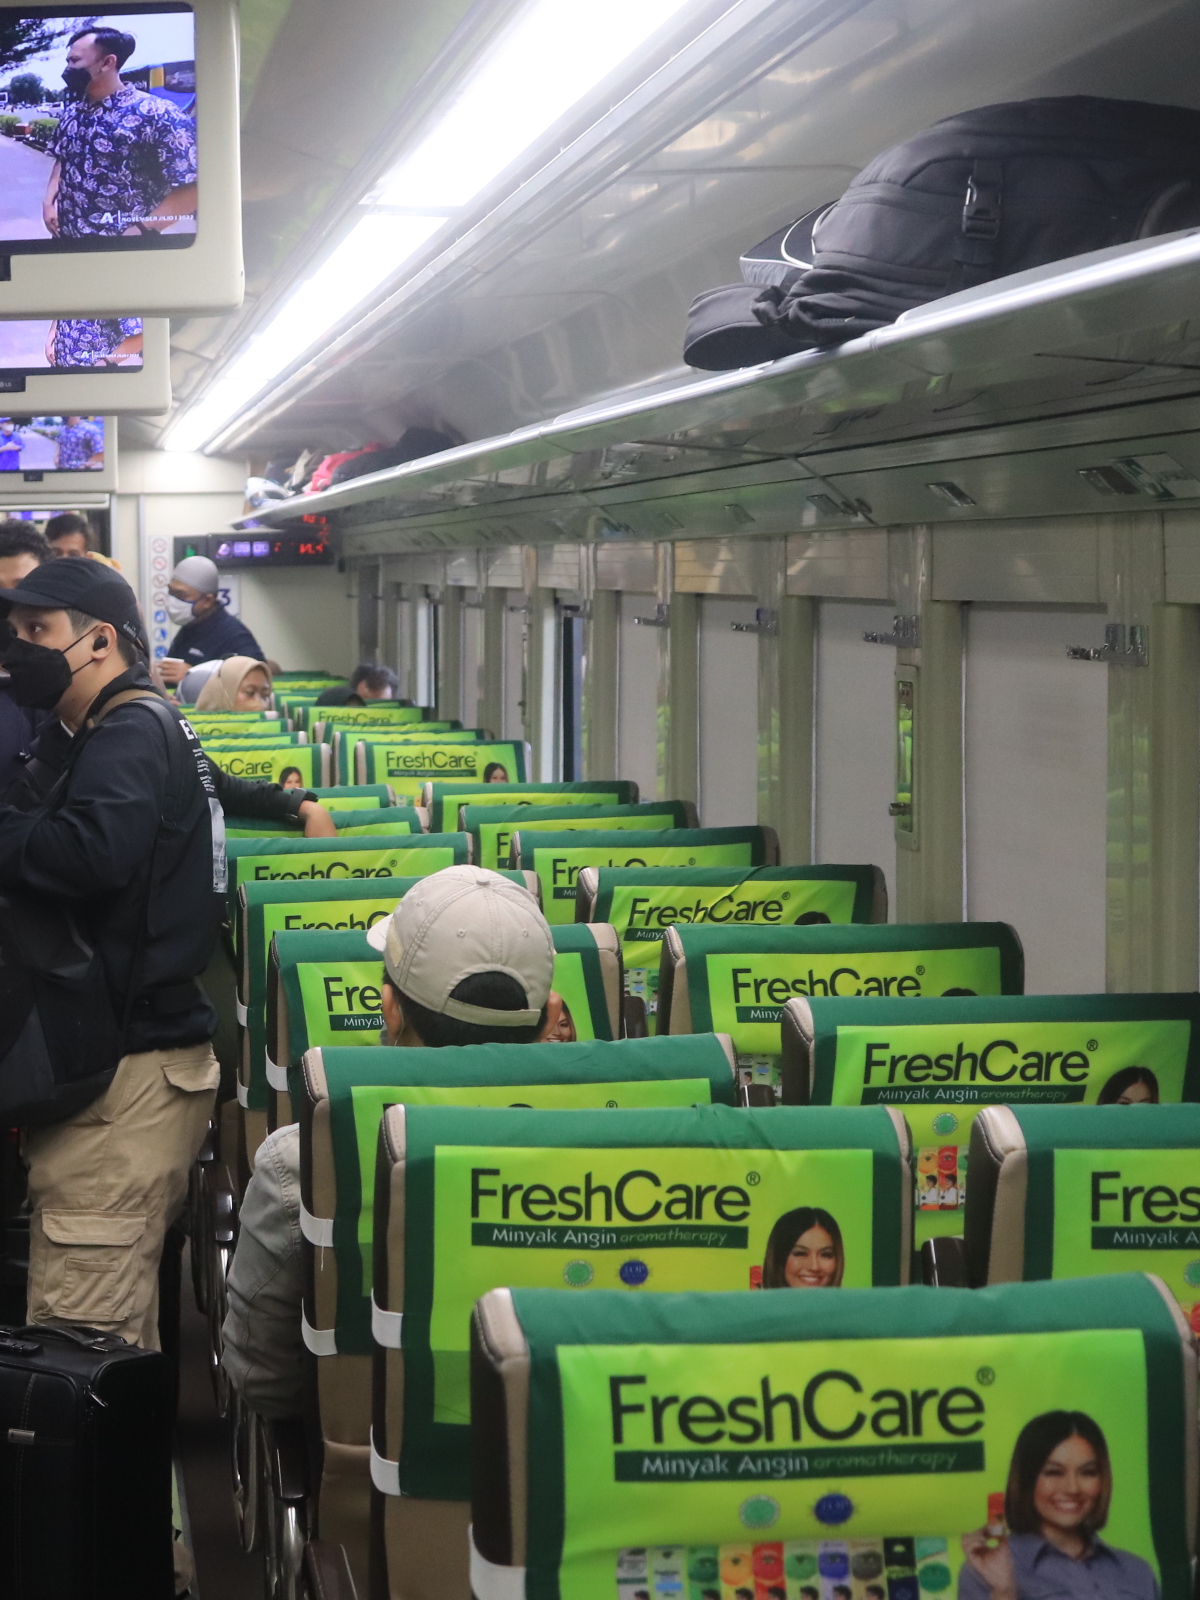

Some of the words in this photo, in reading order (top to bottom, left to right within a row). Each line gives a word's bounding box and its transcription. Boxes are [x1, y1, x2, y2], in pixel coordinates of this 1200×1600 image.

[878, 1088, 930, 1103] Minyak
[934, 1086, 978, 1102] Angin
[980, 1088, 1069, 1101] aromatherapy
[492, 1228, 557, 1246] Minyak
[563, 1229, 617, 1248] Angin
[620, 1228, 727, 1246] aromatherapy
[1113, 1229, 1179, 1247] Minyak
[642, 1456, 730, 1479] Minyak
[737, 1453, 809, 1478] Angin
[812, 1450, 957, 1471] aromatherapy
